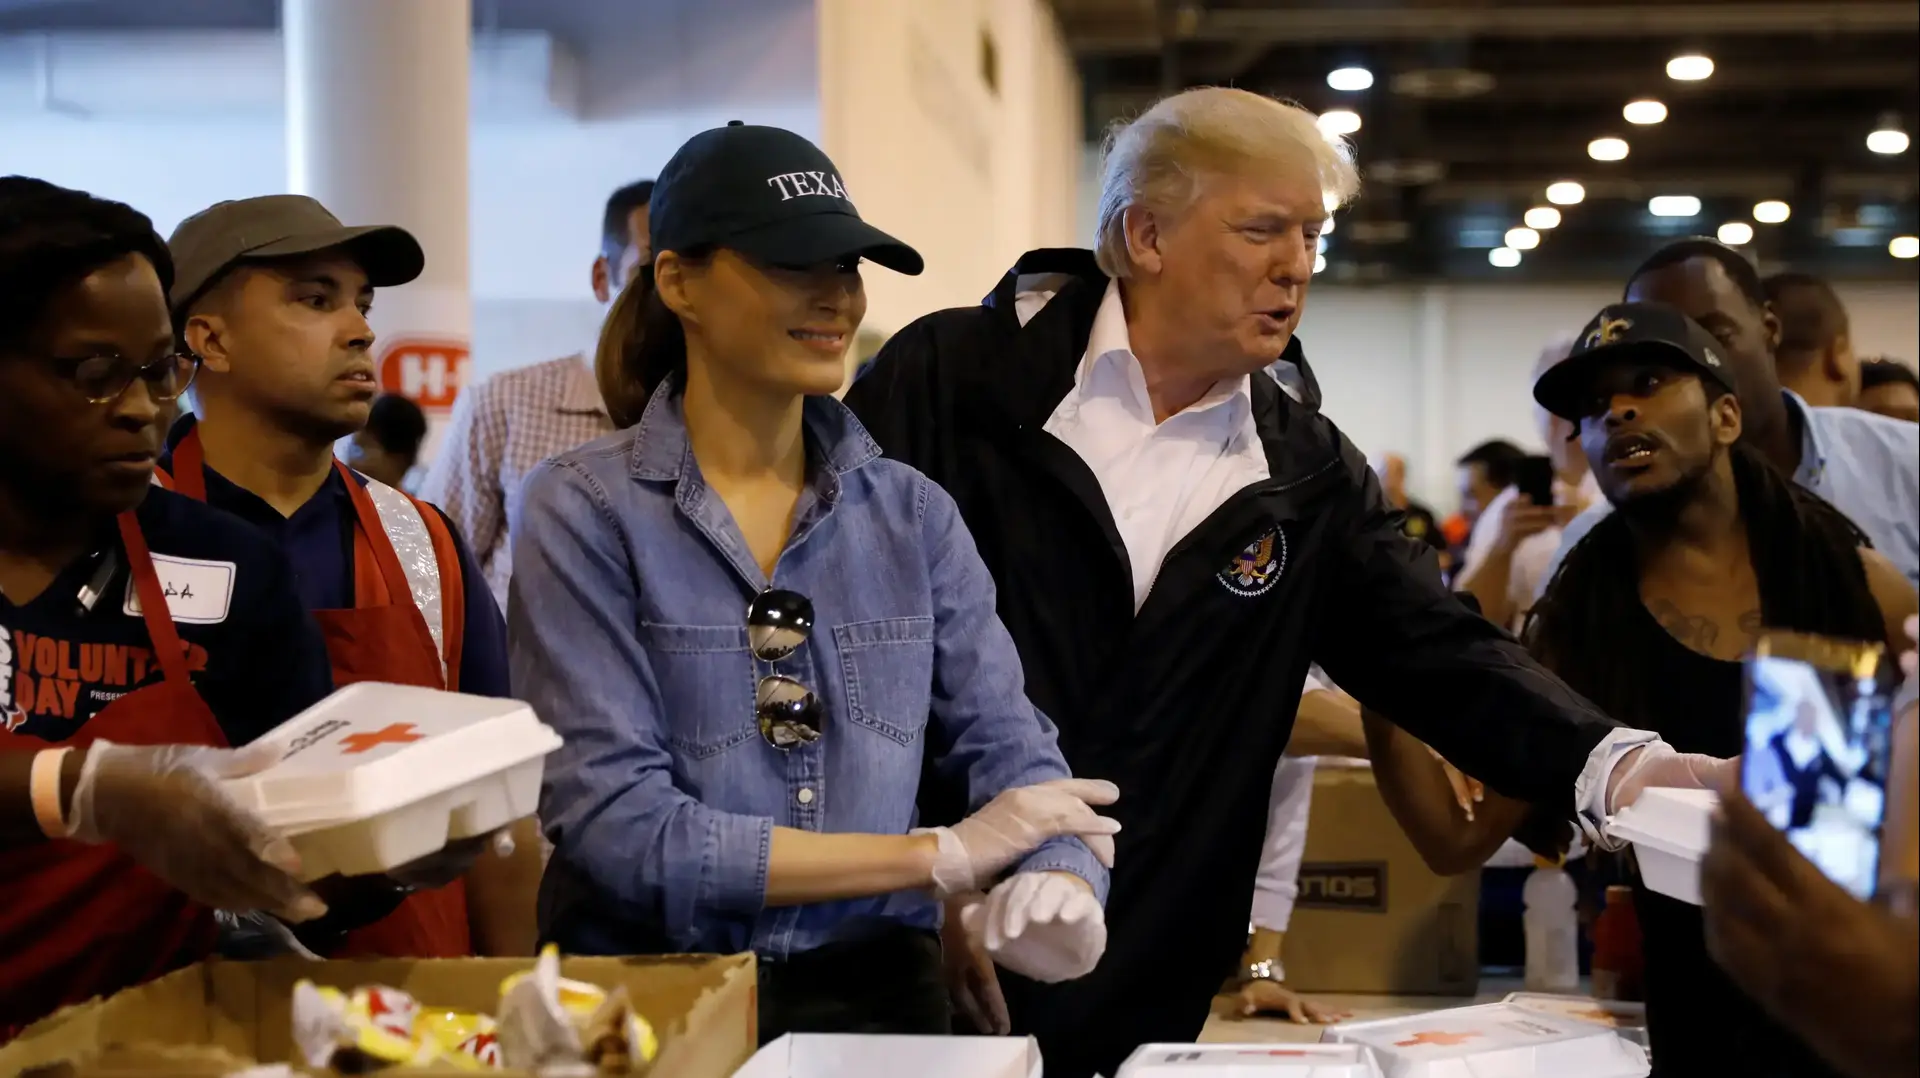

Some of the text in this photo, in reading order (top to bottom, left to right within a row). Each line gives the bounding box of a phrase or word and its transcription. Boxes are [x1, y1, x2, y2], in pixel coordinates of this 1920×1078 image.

[14, 630, 208, 686] VOLUNTR
[15, 671, 81, 719] DAY
[90, 690, 128, 701] PRESEN
